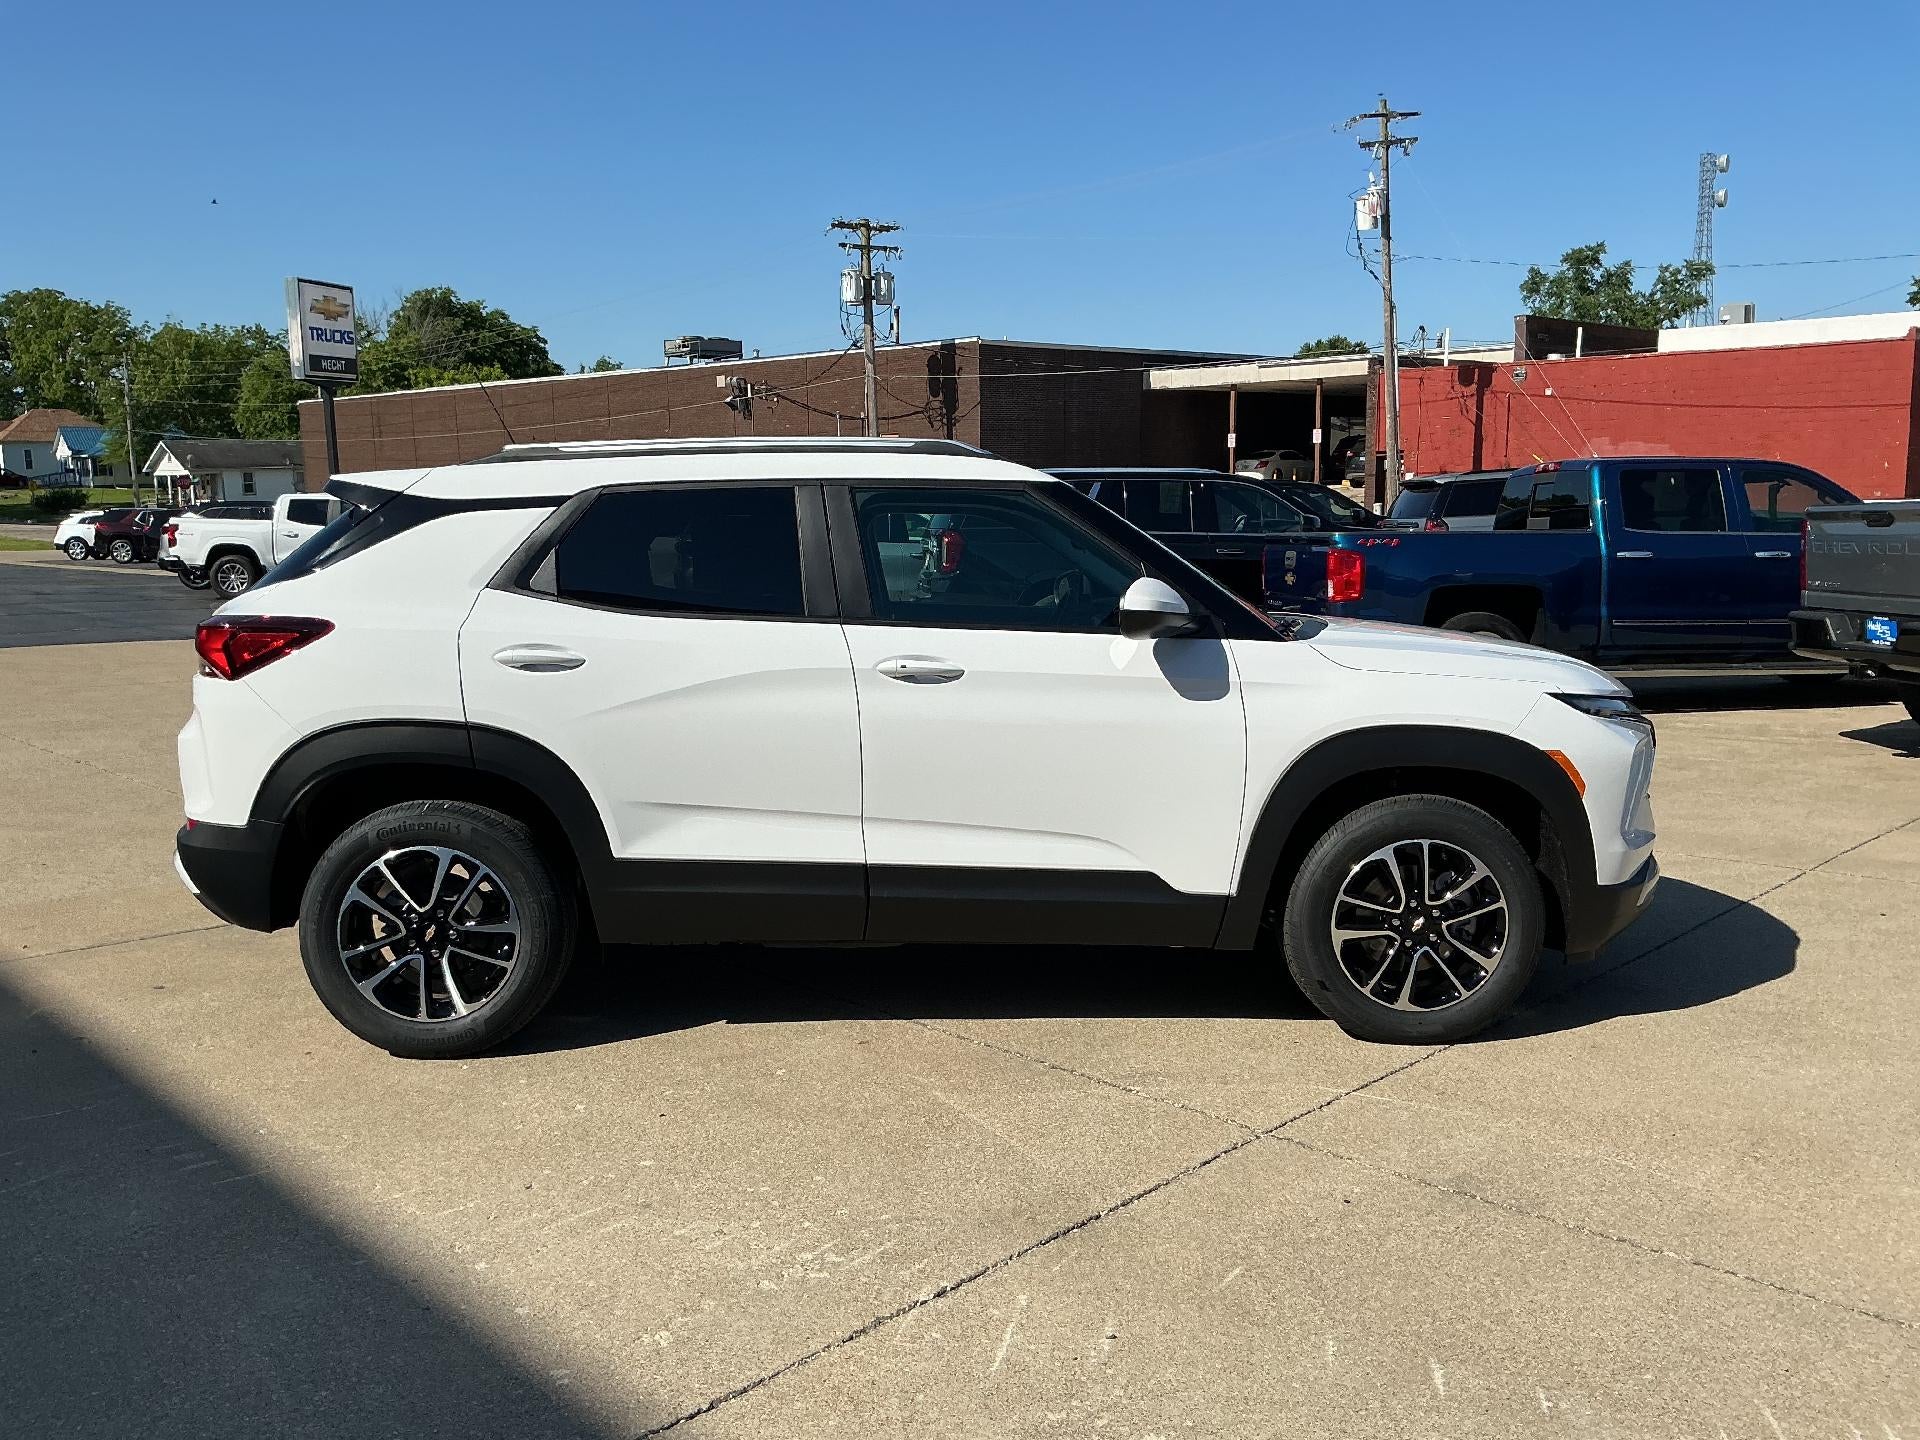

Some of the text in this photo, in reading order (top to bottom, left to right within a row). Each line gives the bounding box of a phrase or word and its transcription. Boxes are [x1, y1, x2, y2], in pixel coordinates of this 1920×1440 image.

[309, 326, 355, 345] TRUCKS
[321, 359, 346, 371] HECHT
[376, 820, 452, 842] Continental
